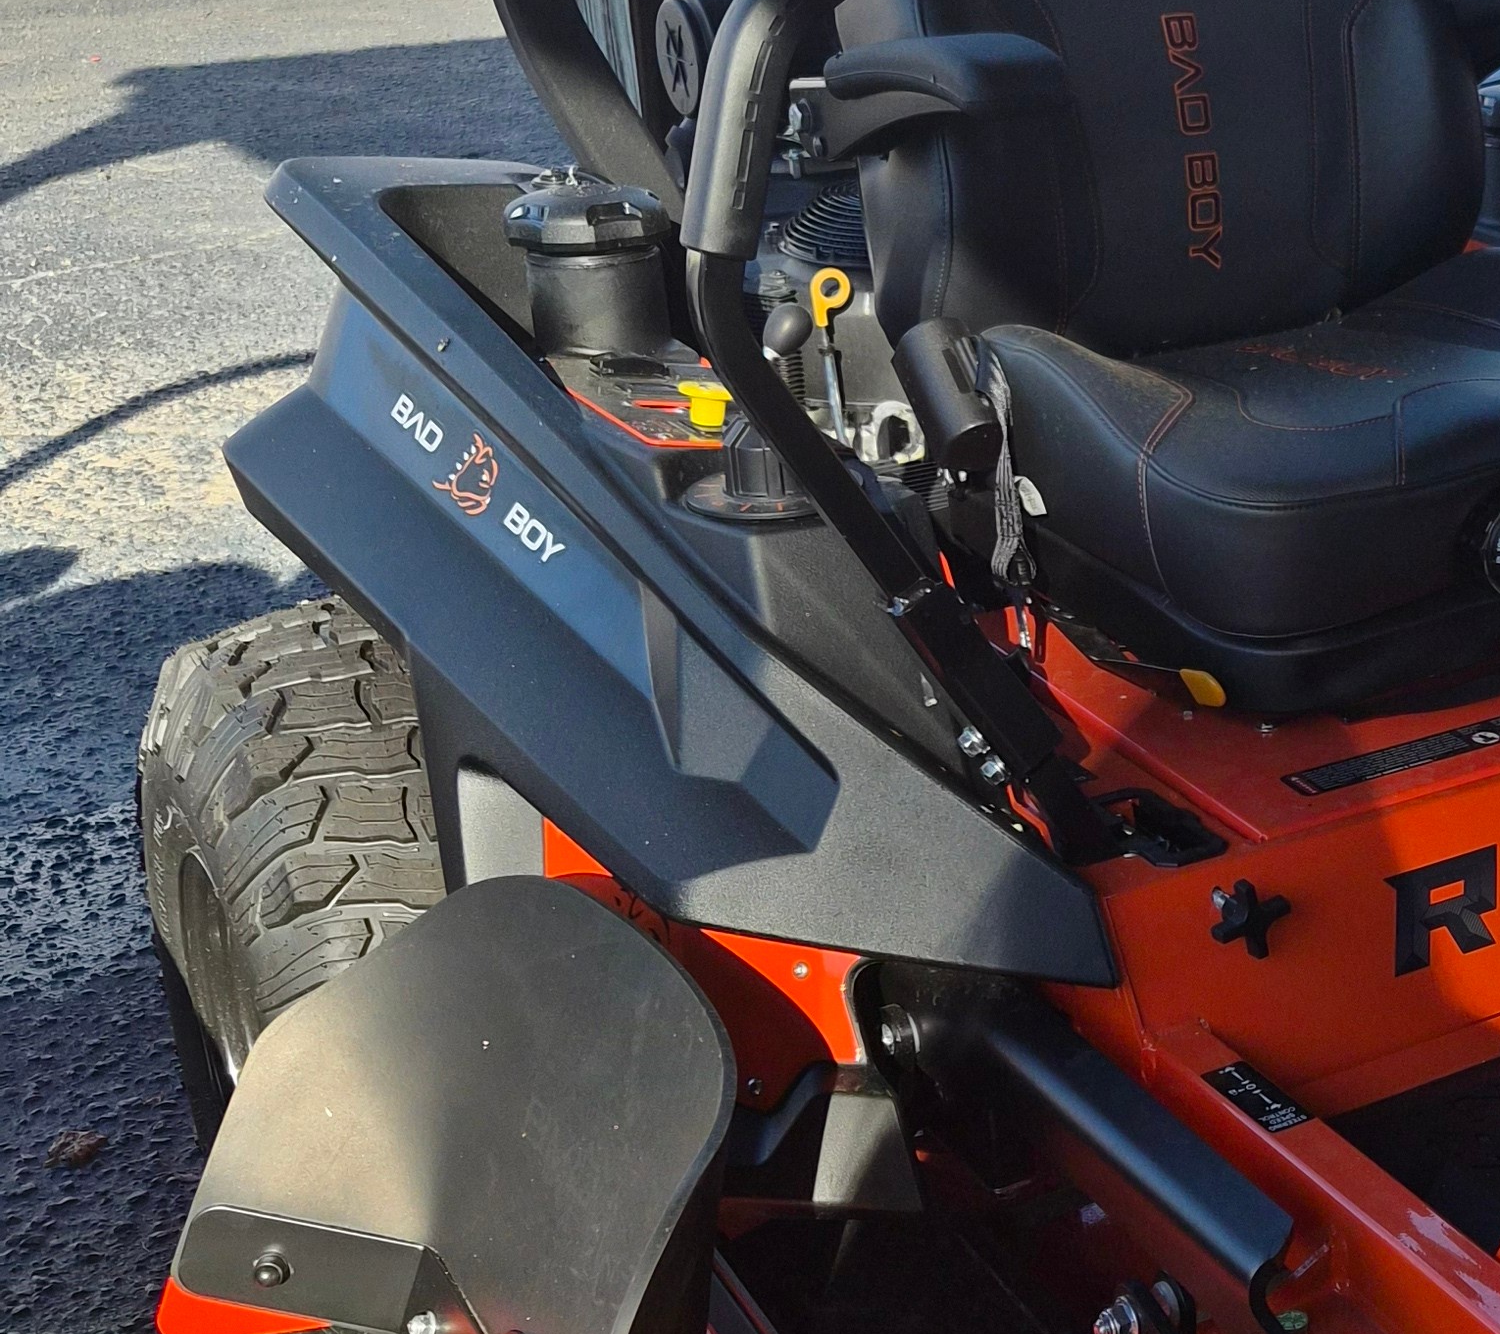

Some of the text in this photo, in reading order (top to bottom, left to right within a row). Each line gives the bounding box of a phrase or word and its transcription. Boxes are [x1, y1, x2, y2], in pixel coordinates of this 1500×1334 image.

[1161, 12, 1223, 269] BAD BOY
[390, 393, 566, 562] BAD BOY
